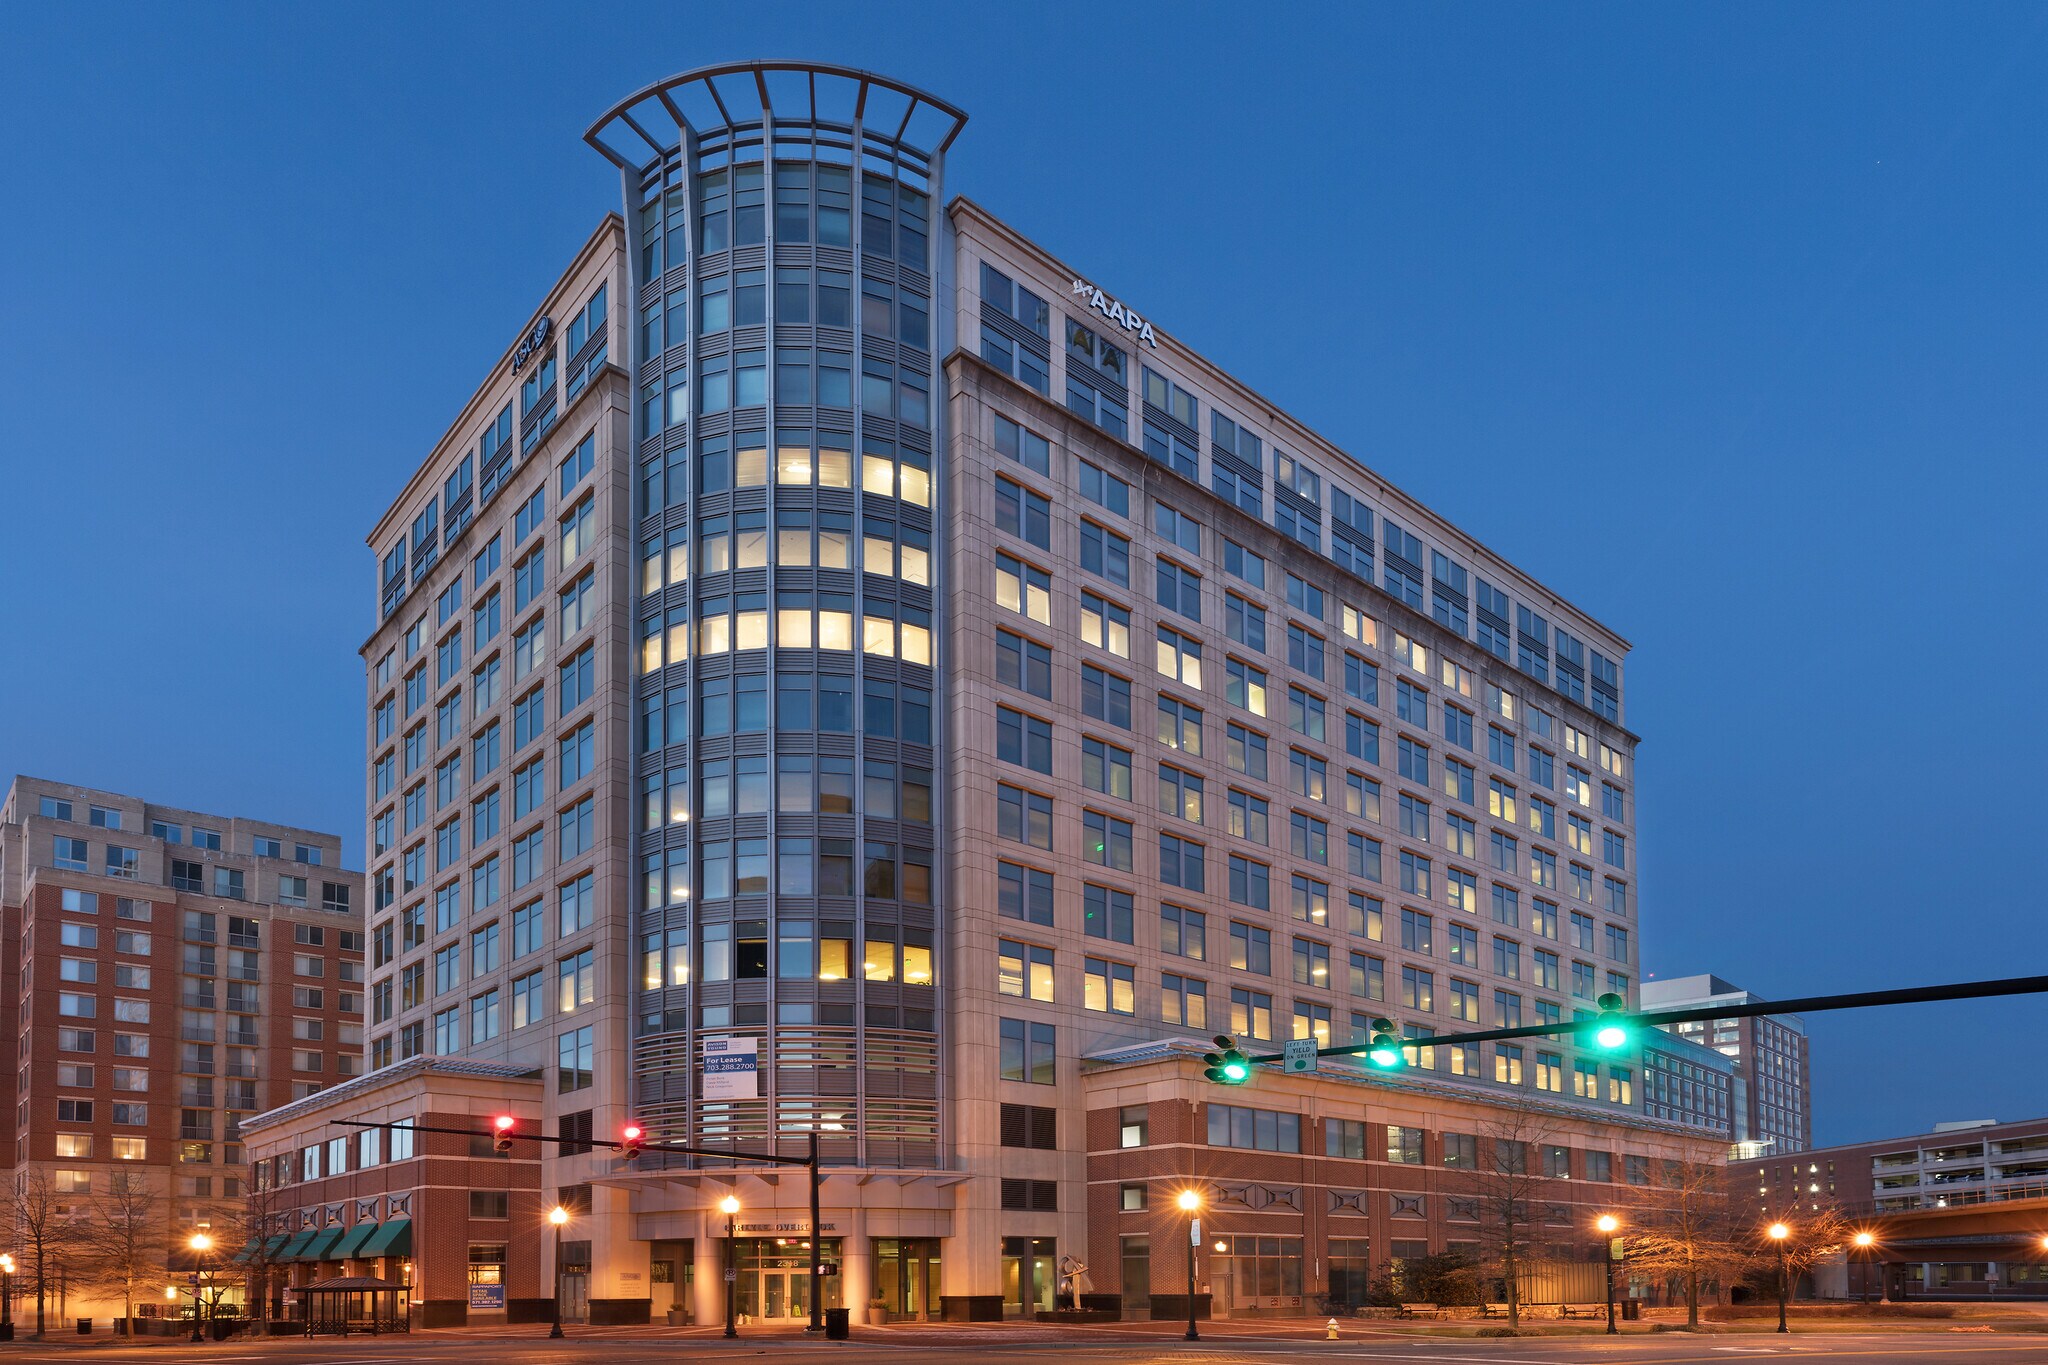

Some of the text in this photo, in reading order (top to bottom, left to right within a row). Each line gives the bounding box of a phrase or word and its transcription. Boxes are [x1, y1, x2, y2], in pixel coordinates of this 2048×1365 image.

[1089, 288, 1157, 349] AAPA
[1292, 1046, 1311, 1054] YIELD
[706, 1063, 755, 1071] 703.288.2700
[774, 1223, 836, 1231] OVERLOK
